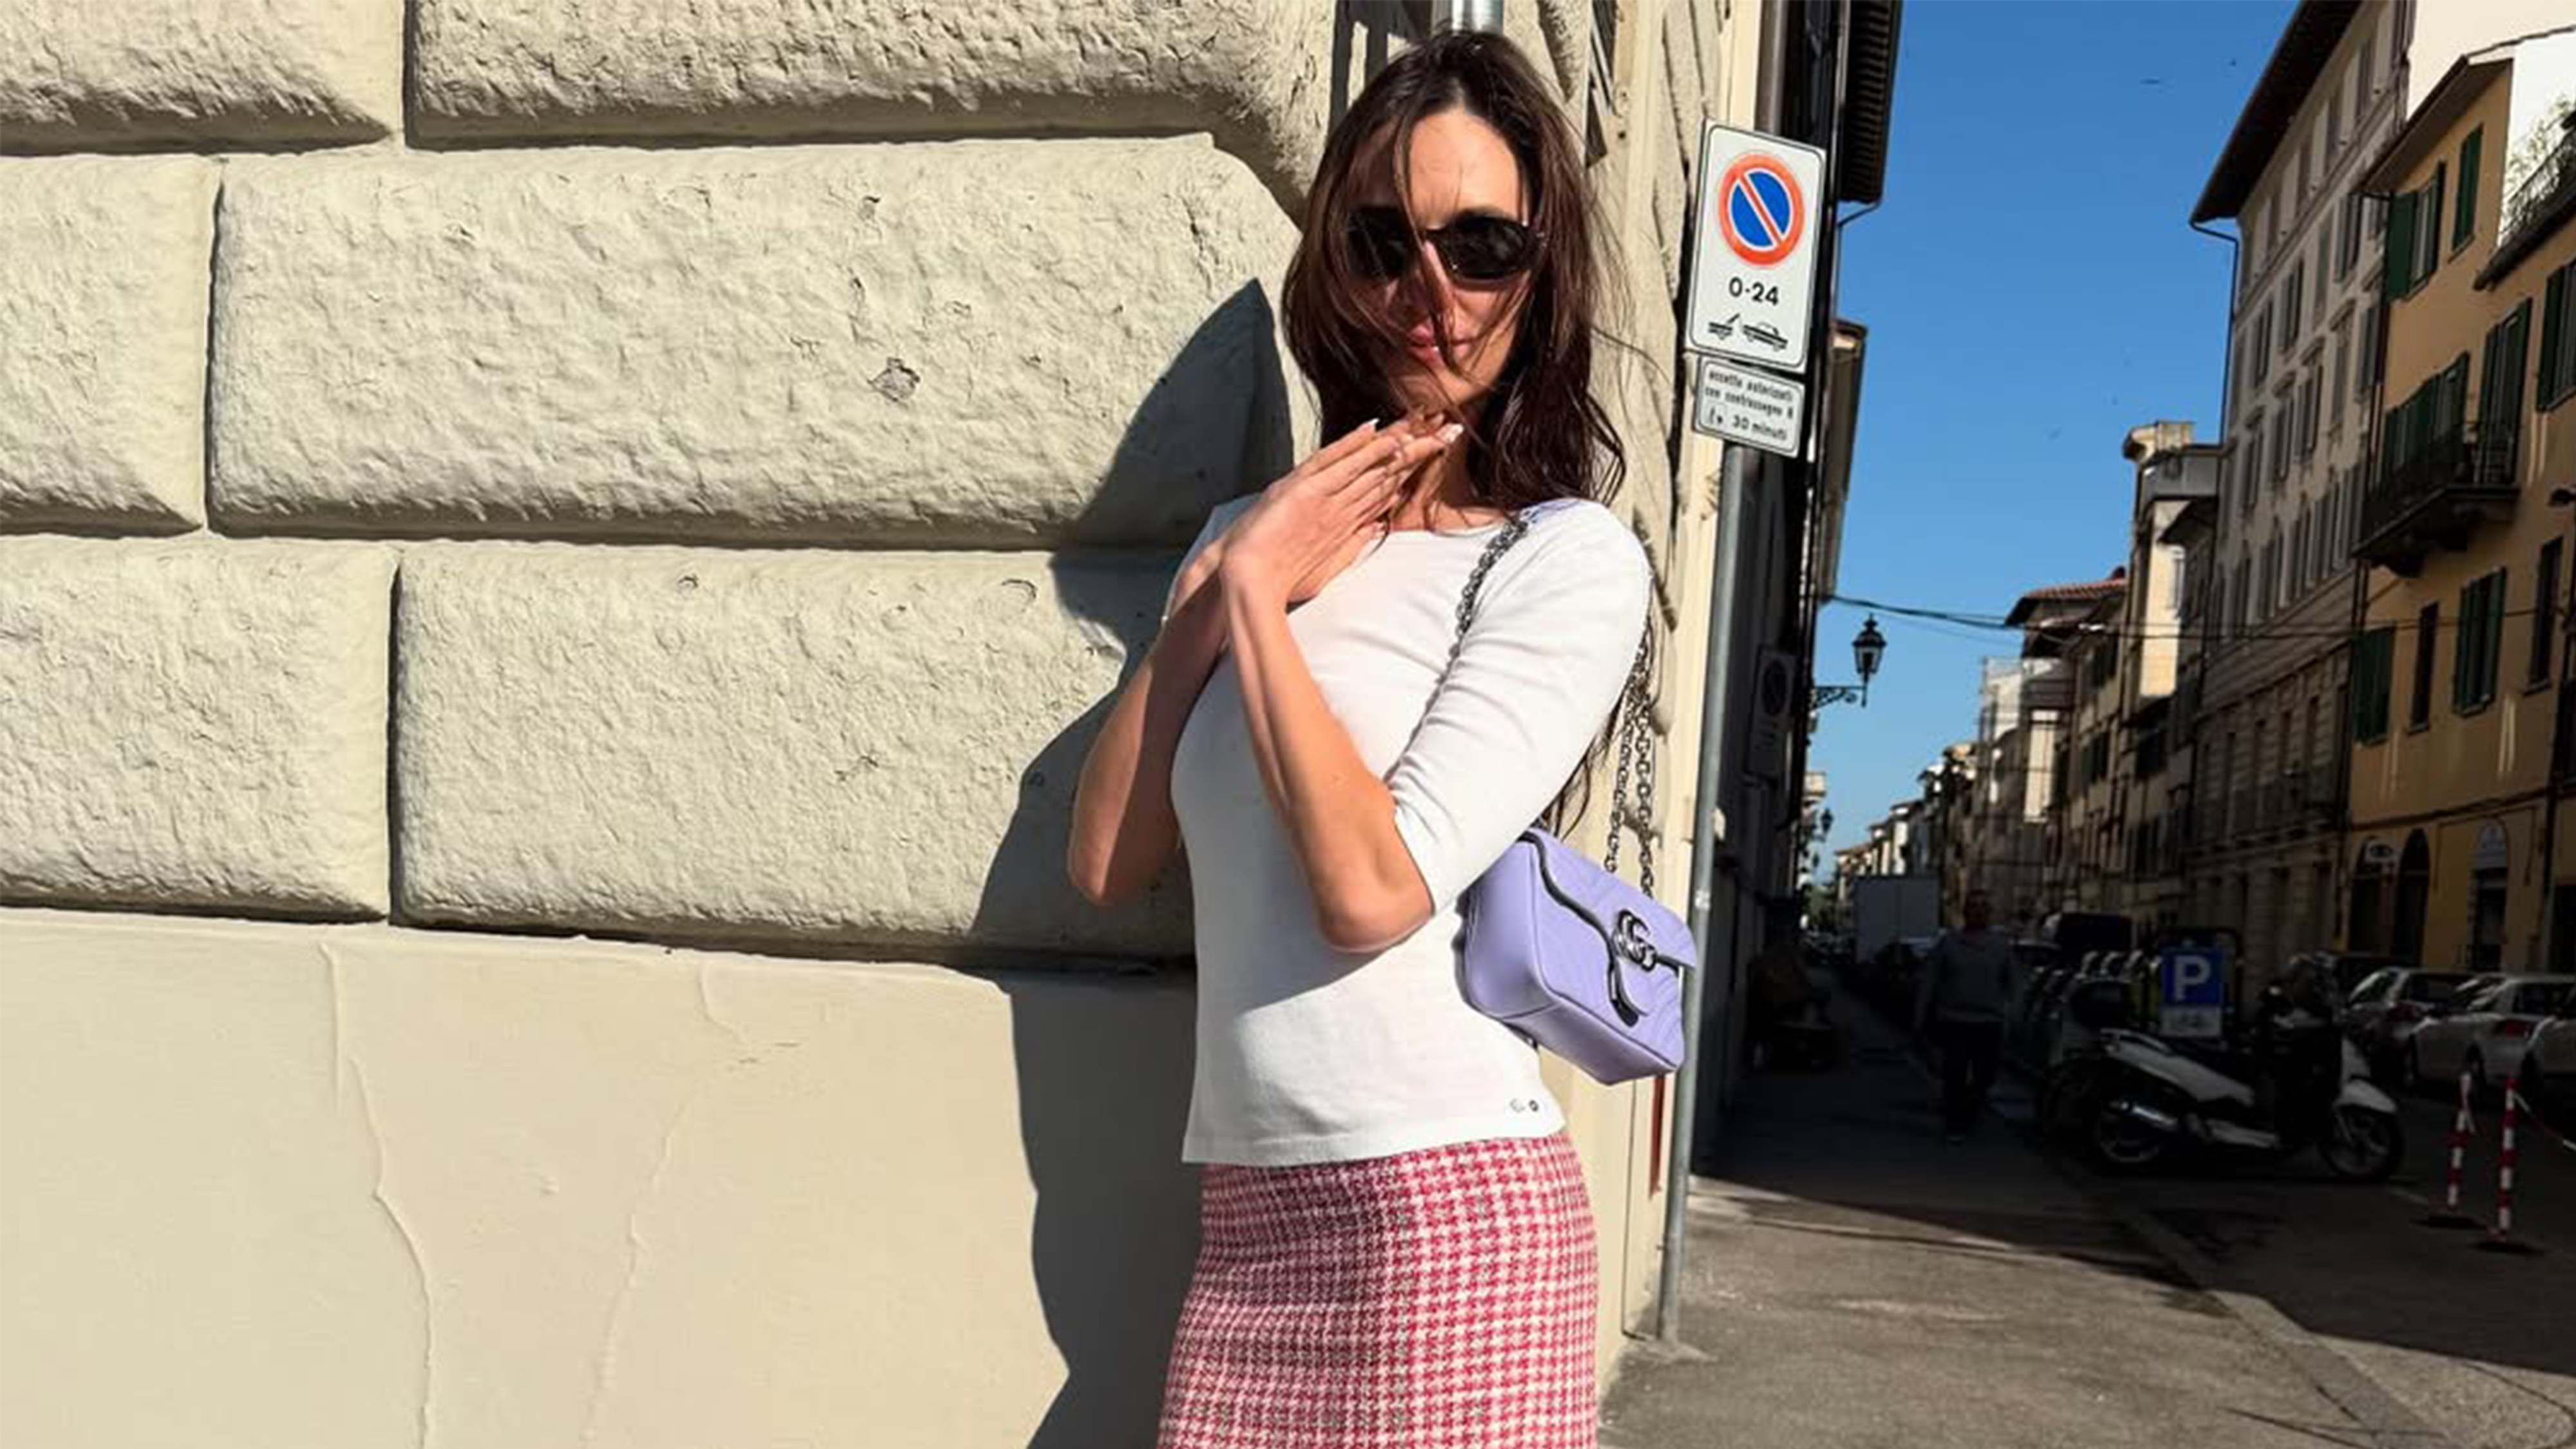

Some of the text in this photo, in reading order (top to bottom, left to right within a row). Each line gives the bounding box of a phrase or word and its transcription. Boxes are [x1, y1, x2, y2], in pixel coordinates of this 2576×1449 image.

[1728, 276, 1779, 306] 0-24
[1705, 387, 1720, 398] con
[1733, 414, 1787, 440] 30 minuti
[2174, 955, 2211, 999] P
